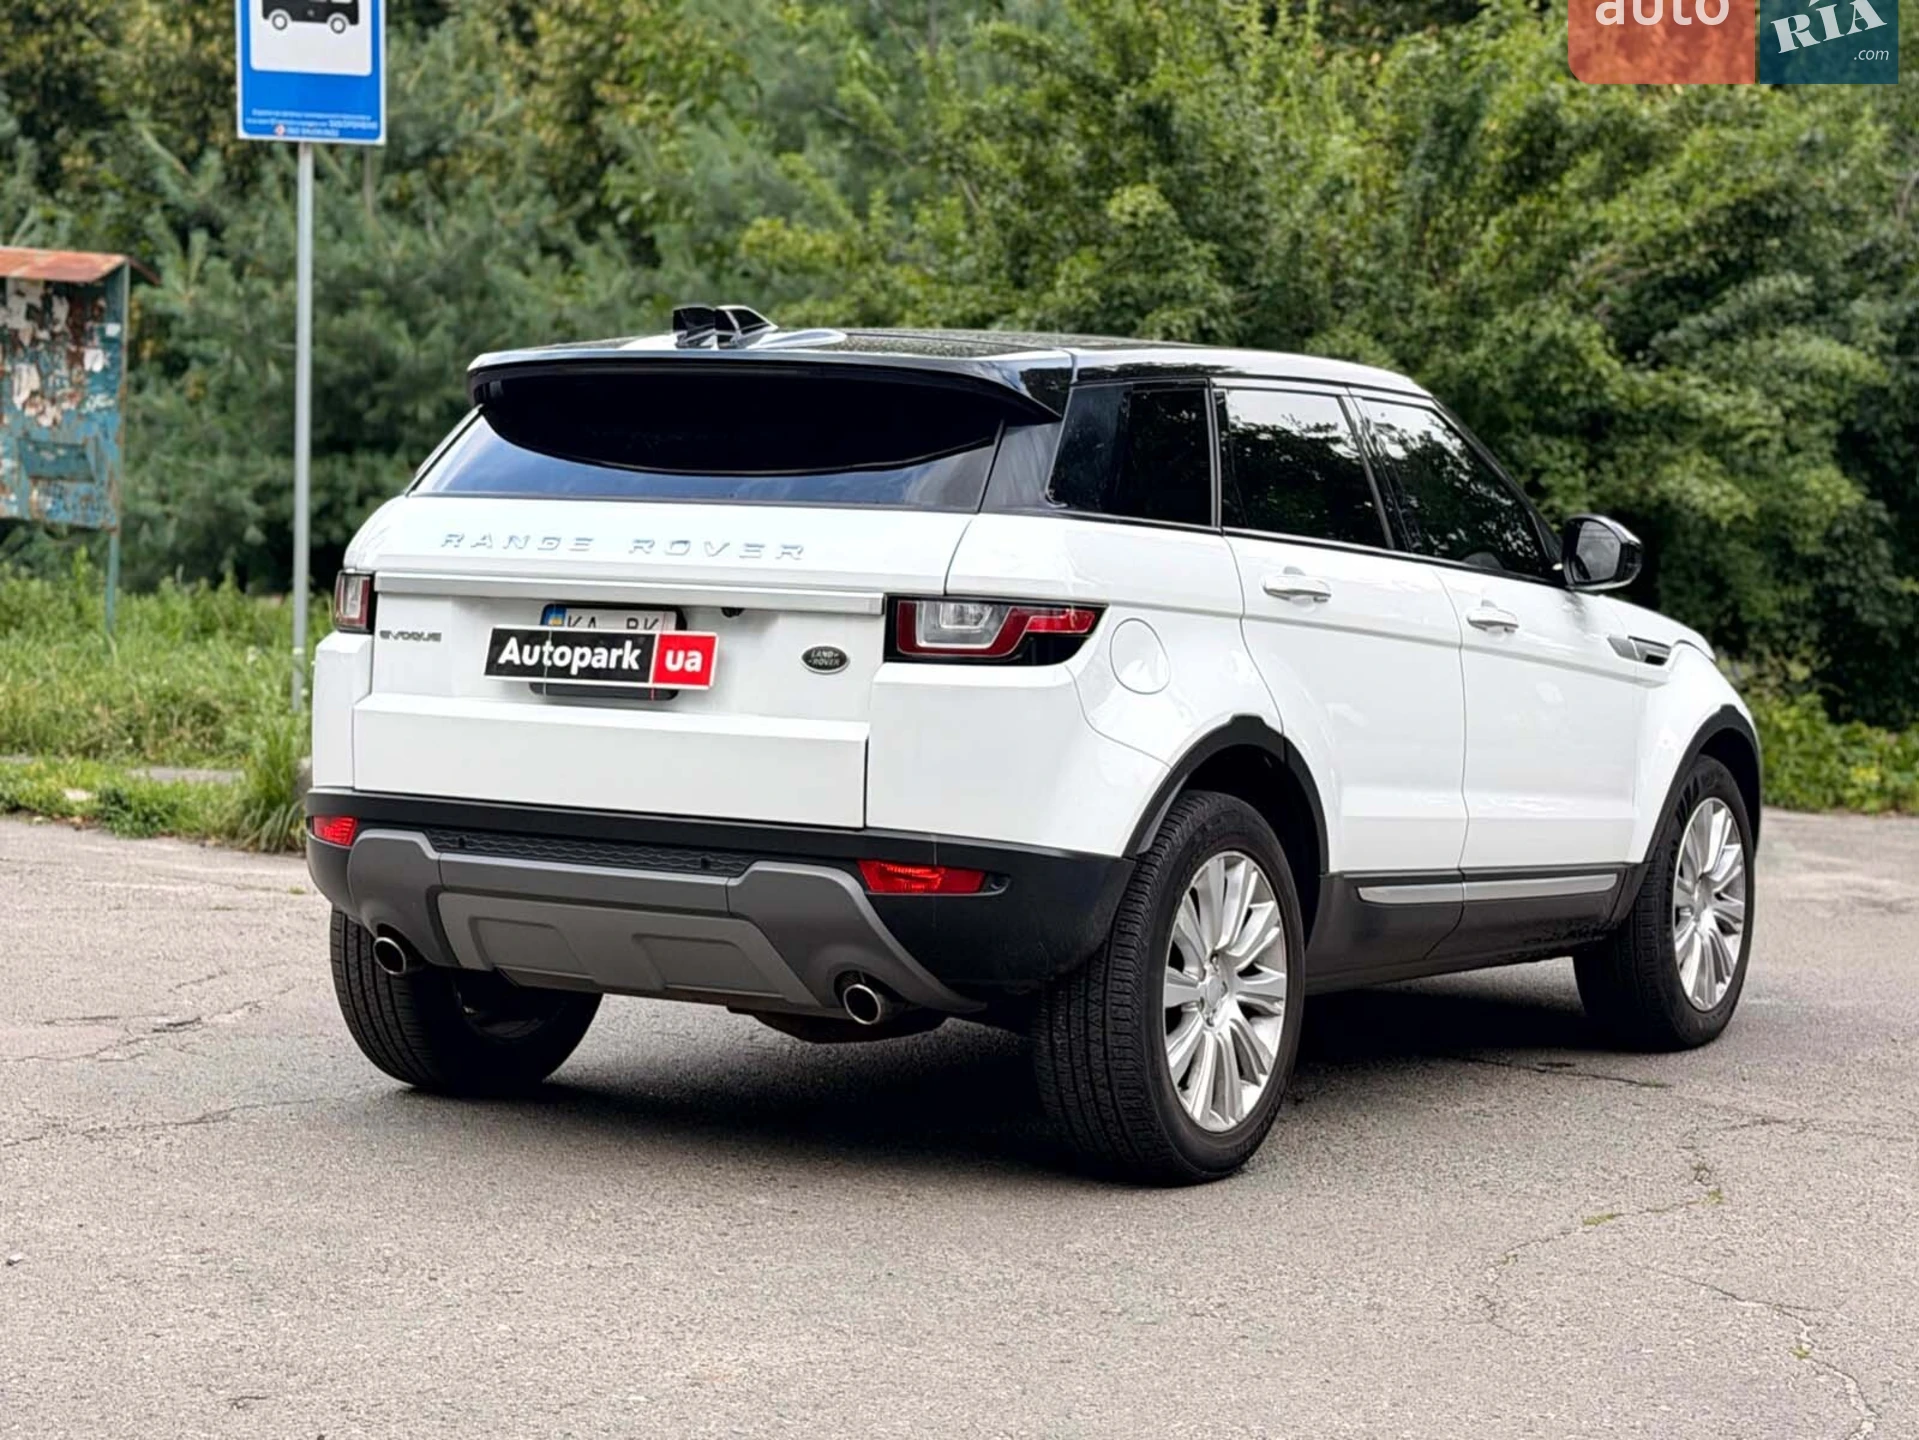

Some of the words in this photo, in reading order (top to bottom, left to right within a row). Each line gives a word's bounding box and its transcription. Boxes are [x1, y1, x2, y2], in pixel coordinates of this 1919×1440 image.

[441, 533, 594, 552] RANGE
[628, 538, 805, 561] ROVER
[379, 630, 442, 642] EVOQUE
[498, 636, 641, 676] Autopark
[665, 648, 703, 673] ua
